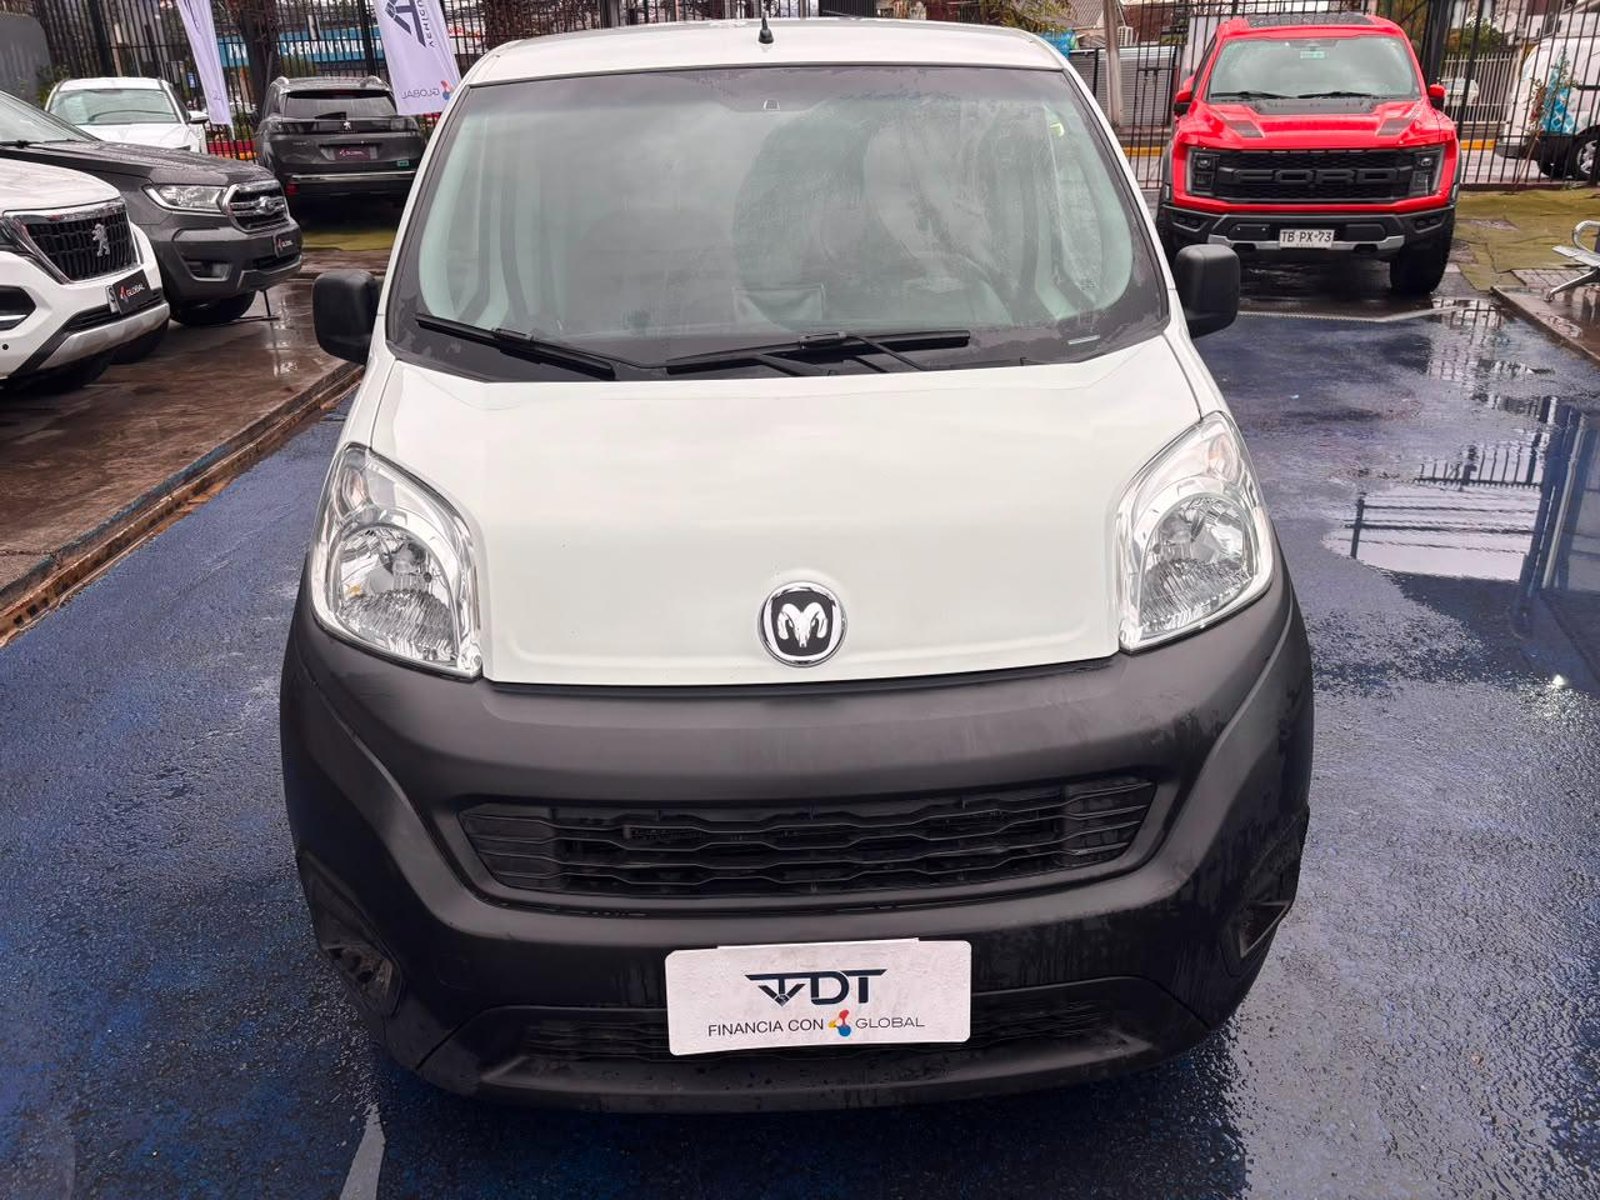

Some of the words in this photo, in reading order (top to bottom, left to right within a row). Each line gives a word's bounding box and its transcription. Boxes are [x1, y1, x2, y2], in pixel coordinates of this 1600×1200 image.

[1233, 168, 1399, 184] FORD
[126, 283, 145, 297] GLOBAL
[708, 1020, 784, 1037] FINANCIA
[788, 1018, 824, 1032] CON
[855, 1016, 926, 1030] GLOBAL
